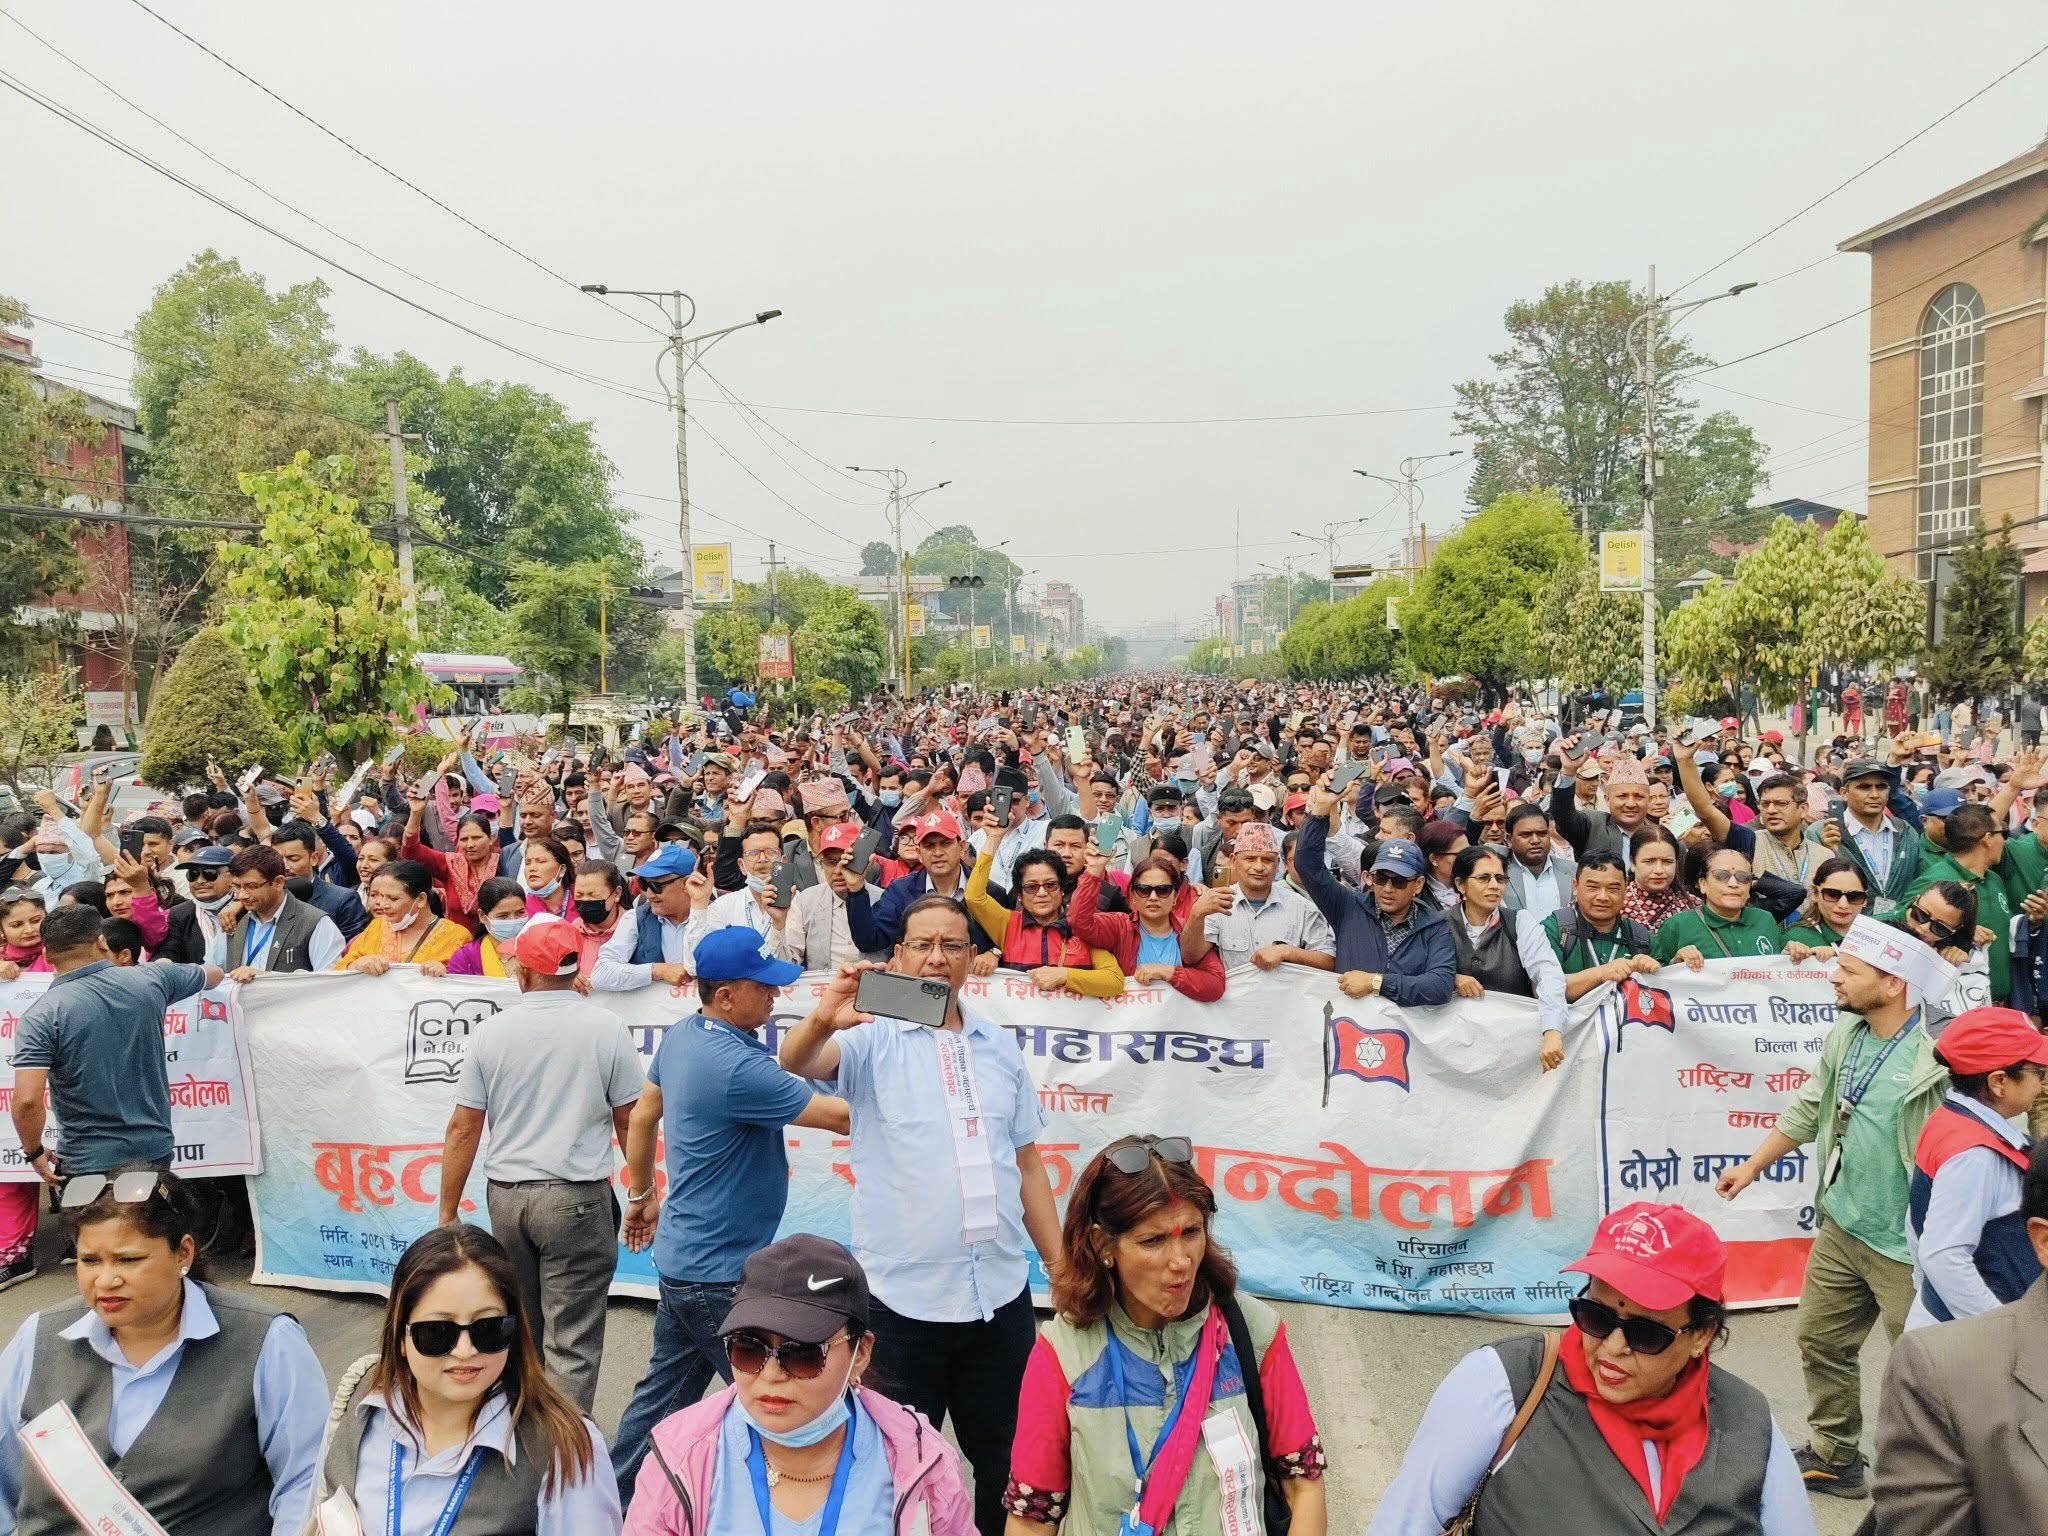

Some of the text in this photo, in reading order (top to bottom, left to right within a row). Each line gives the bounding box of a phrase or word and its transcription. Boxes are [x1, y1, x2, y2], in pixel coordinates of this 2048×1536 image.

[1608, 541, 1636, 549] Delish
[696, 552, 724, 561] Delish
[1731, 969, 1773, 980] अधिकार
[1776, 970, 1784, 980] र
[1684, 996, 1842, 1026] नेपाल शिक्षक
[1755, 1038, 1798, 1053] जिल्ला
[1677, 1063, 1812, 1093] राष्ट्रिय समि
[1192, 1142, 1557, 1230] न्दोलन
[1397, 1236, 1469, 1257] परिचालन
[323, 1254, 354, 1269] स्थान
[370, 1257, 398, 1275] माइती
[1300, 1272, 1577, 1302] राष्ट्रिय आन्दोलन परिचालन समिति
